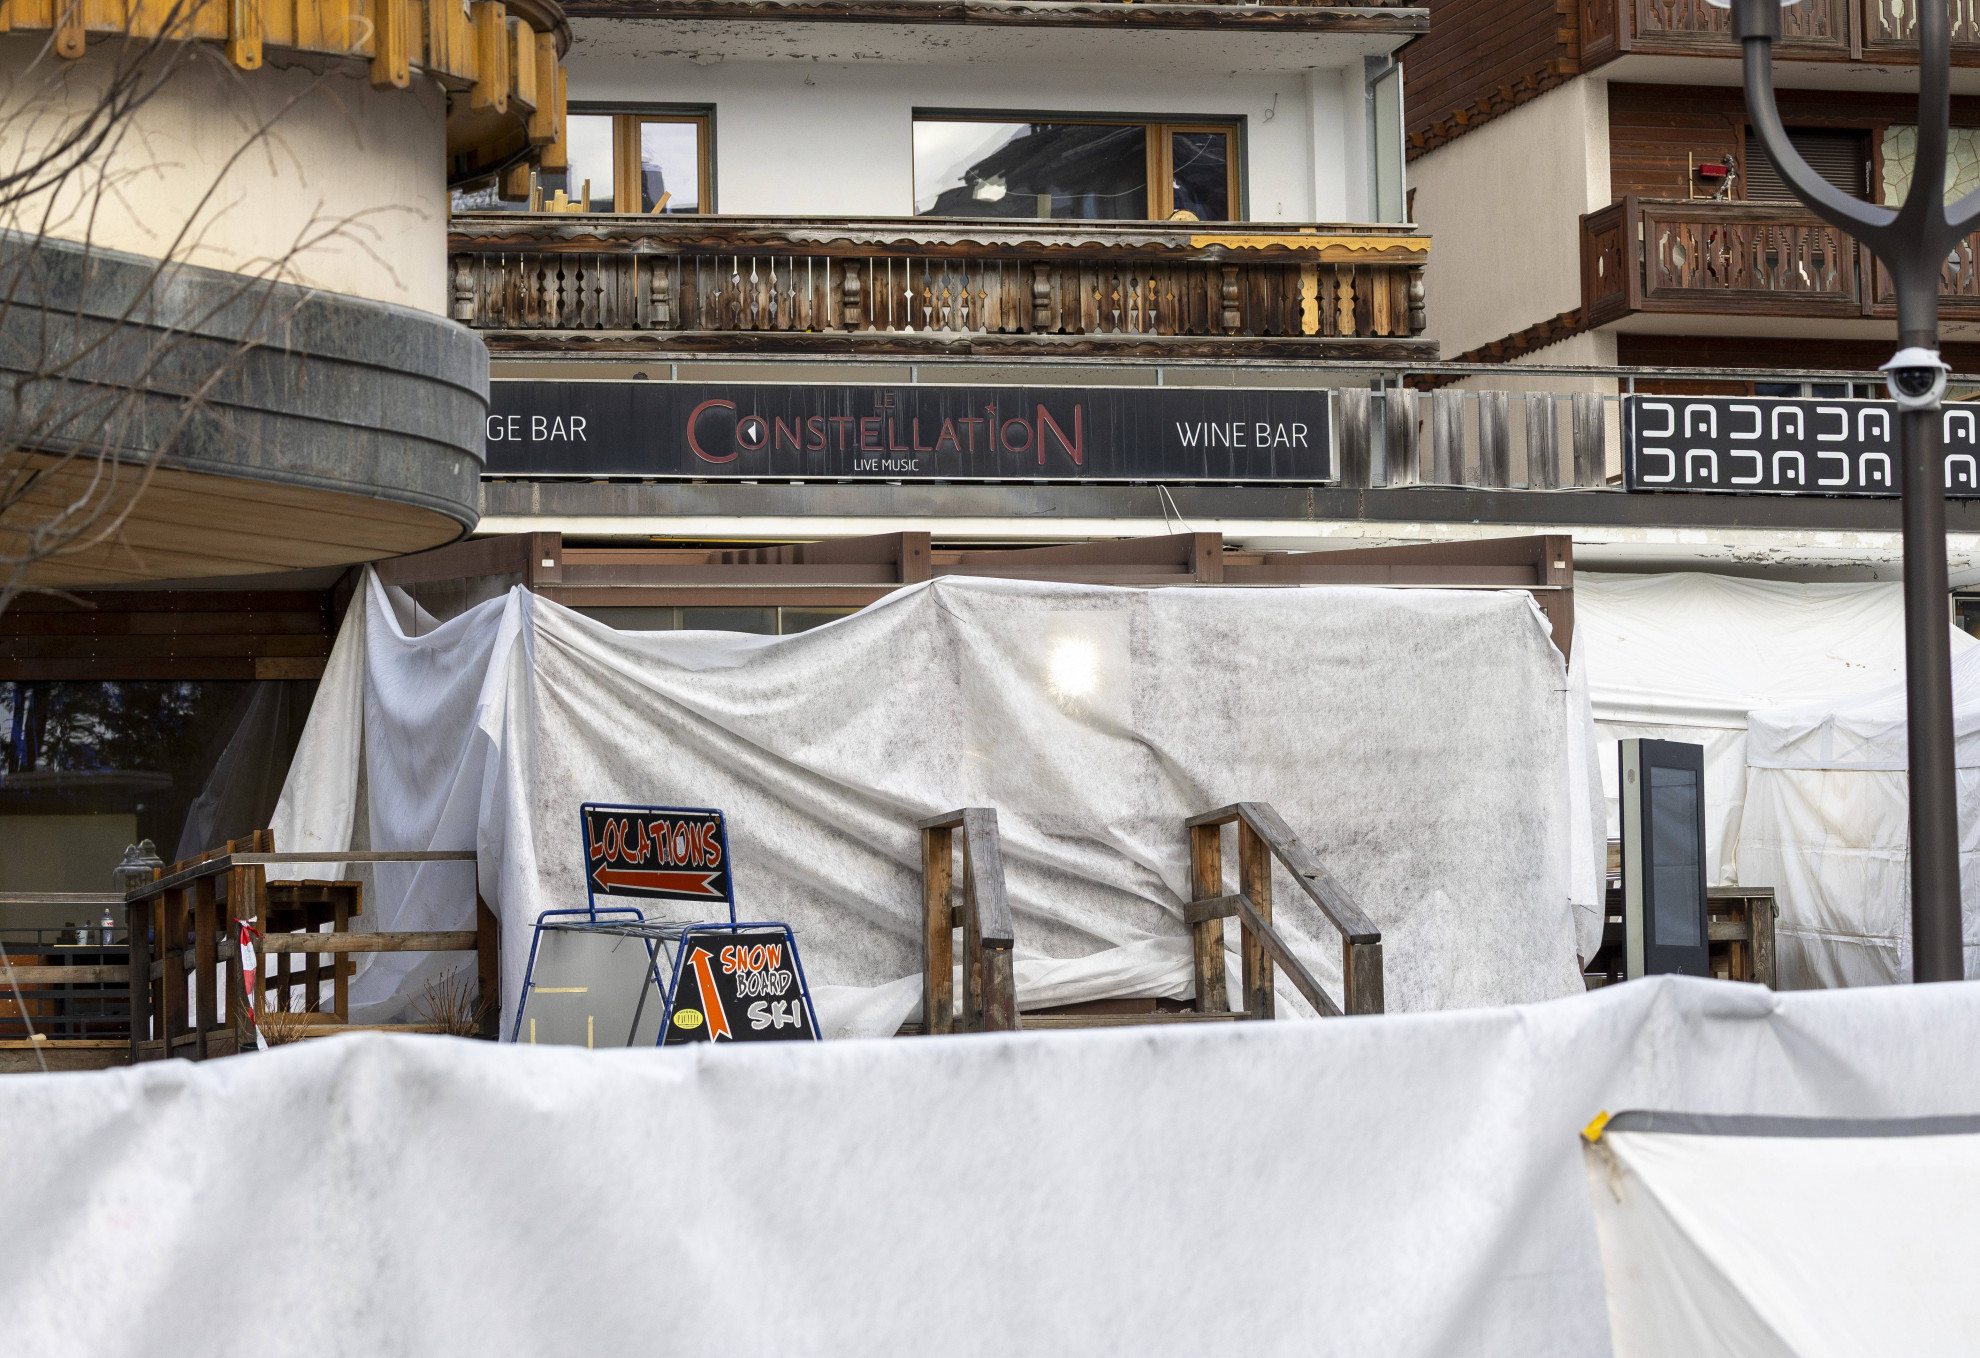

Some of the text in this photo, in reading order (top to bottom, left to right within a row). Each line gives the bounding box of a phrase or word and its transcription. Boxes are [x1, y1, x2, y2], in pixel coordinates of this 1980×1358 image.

[874, 393, 896, 408] LE
[532, 415, 587, 441] BAR
[1176, 420, 1309, 448] WINE BAR
[854, 458, 920, 471] LIVE MUSIC
[588, 816, 722, 868] LOCATIONS
[720, 943, 782, 974] SNOW
[735, 969, 793, 998] BOARD
[747, 998, 802, 1030] SKI
